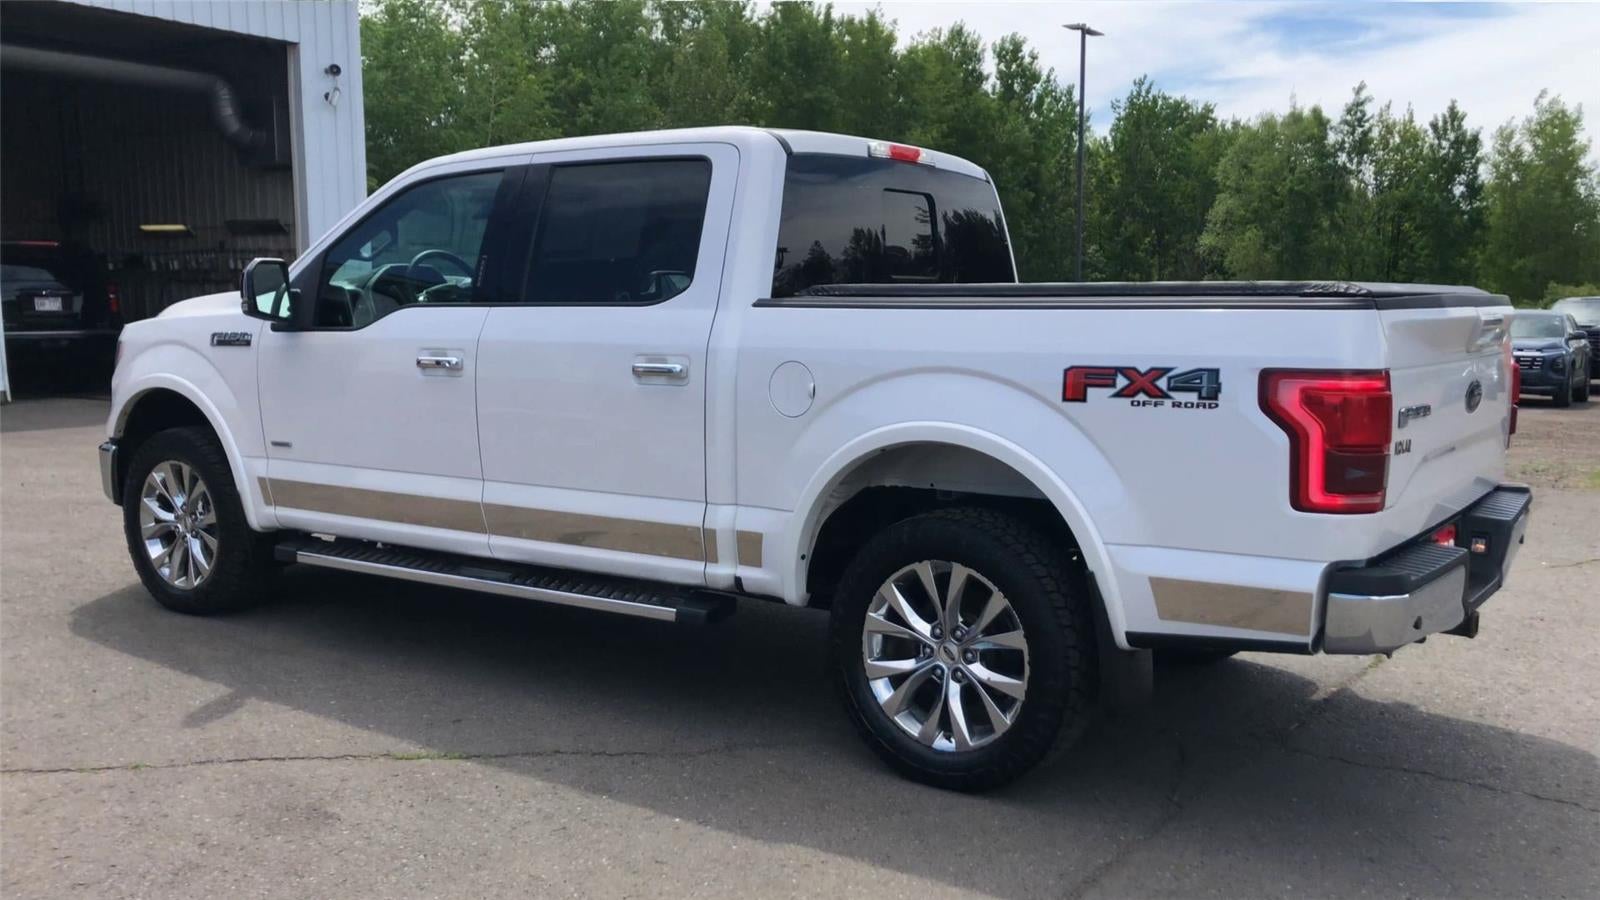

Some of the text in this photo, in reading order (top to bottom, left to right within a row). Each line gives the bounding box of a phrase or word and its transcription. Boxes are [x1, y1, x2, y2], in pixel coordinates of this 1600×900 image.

[1062, 365, 1221, 402] FX4
[1130, 400, 1220, 410] OFF ROAD
